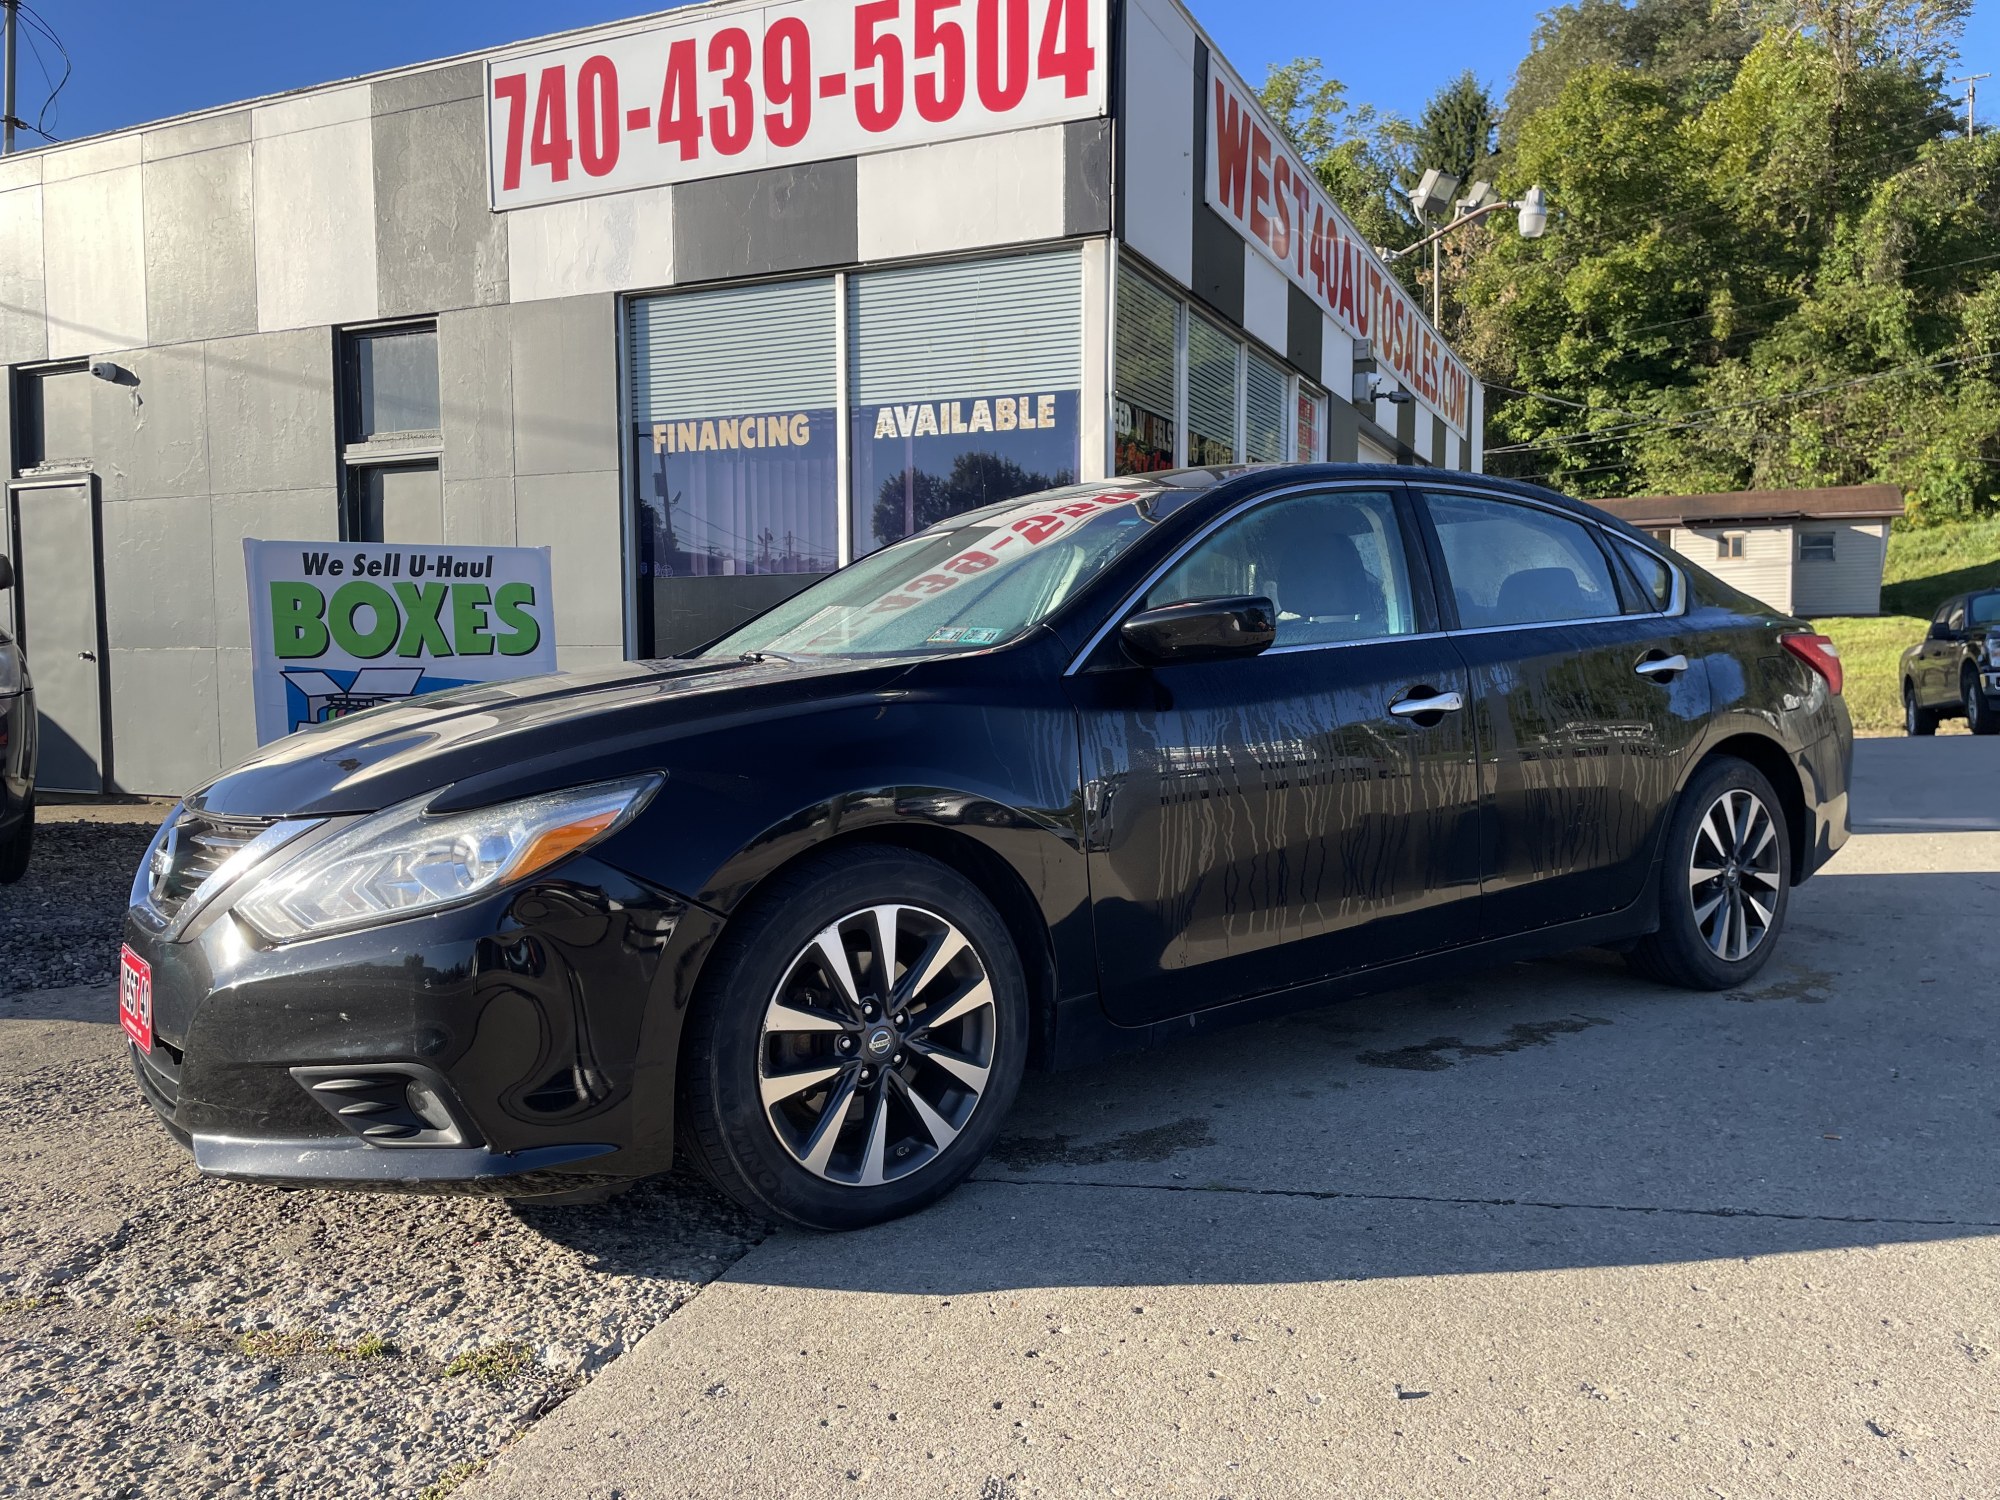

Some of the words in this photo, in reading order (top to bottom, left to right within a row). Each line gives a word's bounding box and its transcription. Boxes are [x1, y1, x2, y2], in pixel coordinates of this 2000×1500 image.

[494, 0, 1095, 192] 740-439-5504
[652, 413, 811, 454] FINANCING
[874, 394, 1056, 439] AVAILABLE
[302, 552, 344, 577] We
[352, 553, 400, 577] Sell
[408, 554, 494, 578] U-Haul
[269, 580, 541, 659] BOXES
